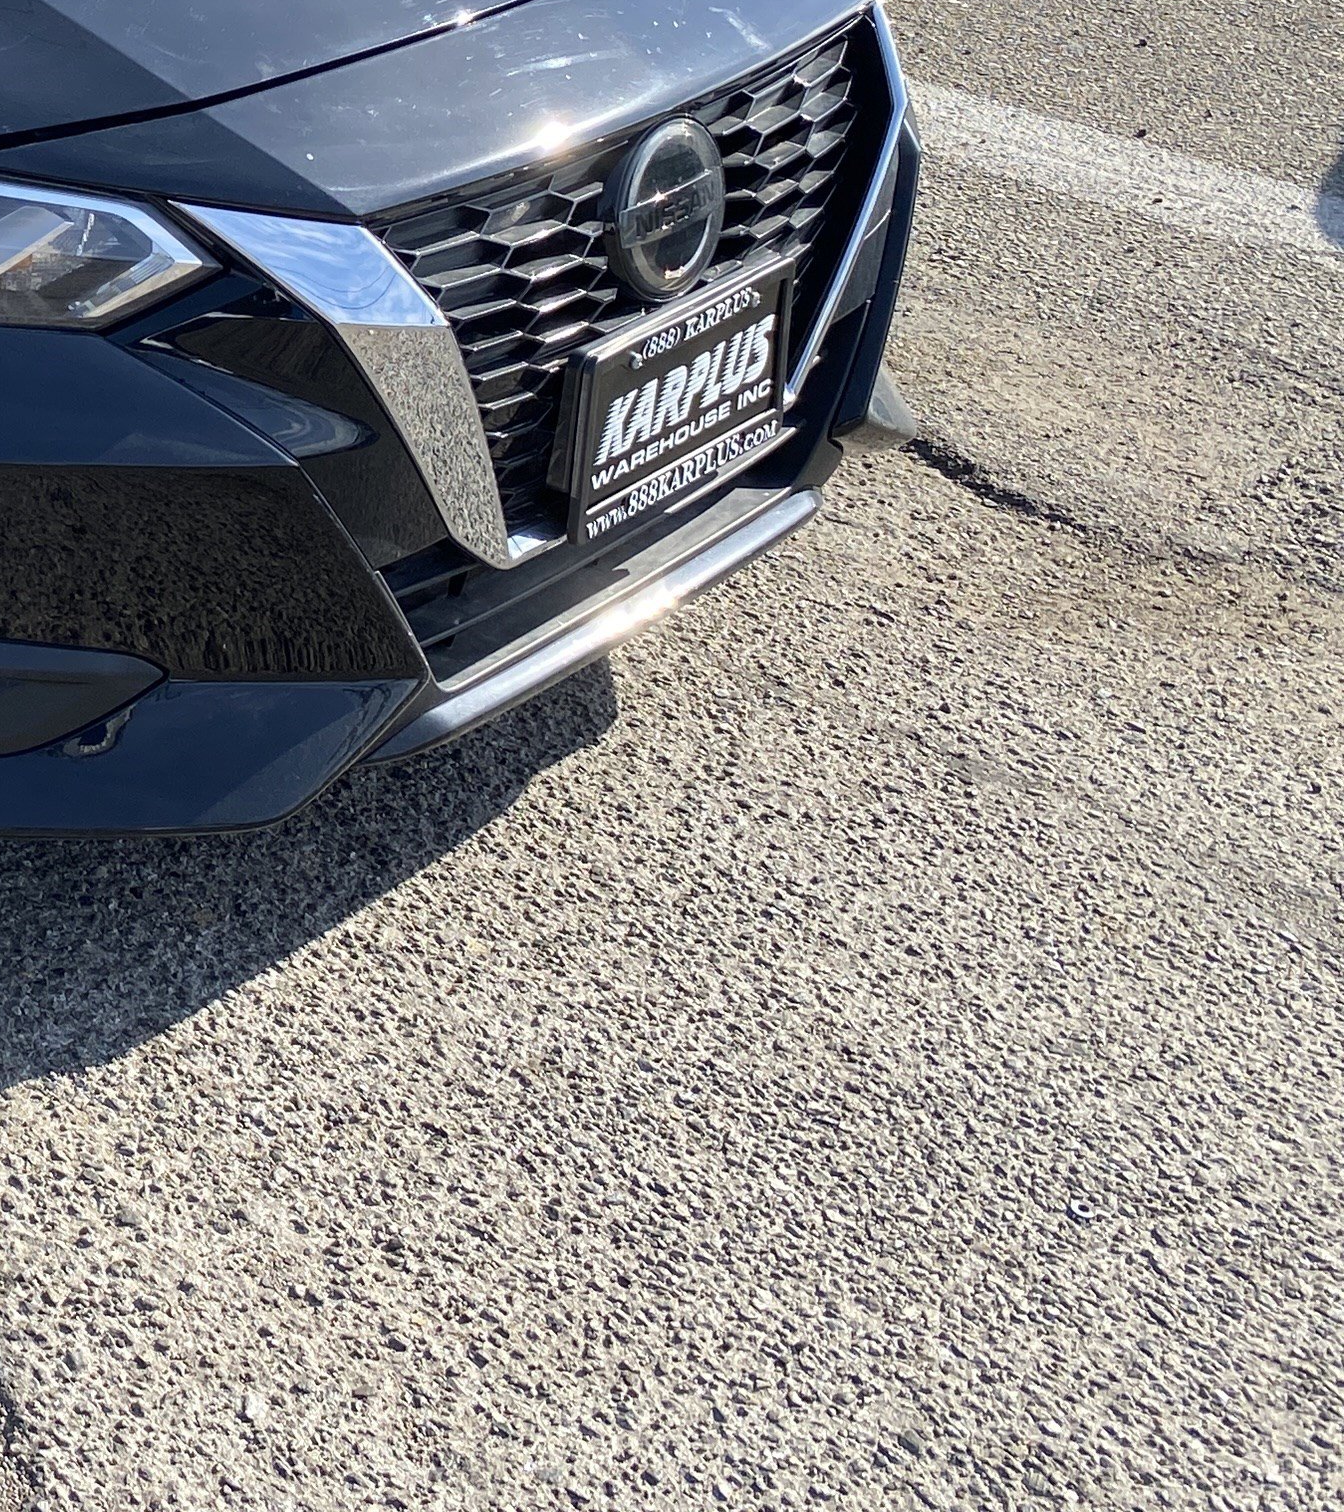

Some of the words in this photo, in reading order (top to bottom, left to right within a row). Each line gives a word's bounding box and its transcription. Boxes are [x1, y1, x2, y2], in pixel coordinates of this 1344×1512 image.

[635, 179, 715, 241] NISSAN
[642, 326, 682, 360] (888)
[683, 286, 753, 341] KARPLUS
[591, 400, 732, 491] WAREHOUSE
[737, 378, 772, 411] INC
[593, 314, 776, 466] KARPLUS
